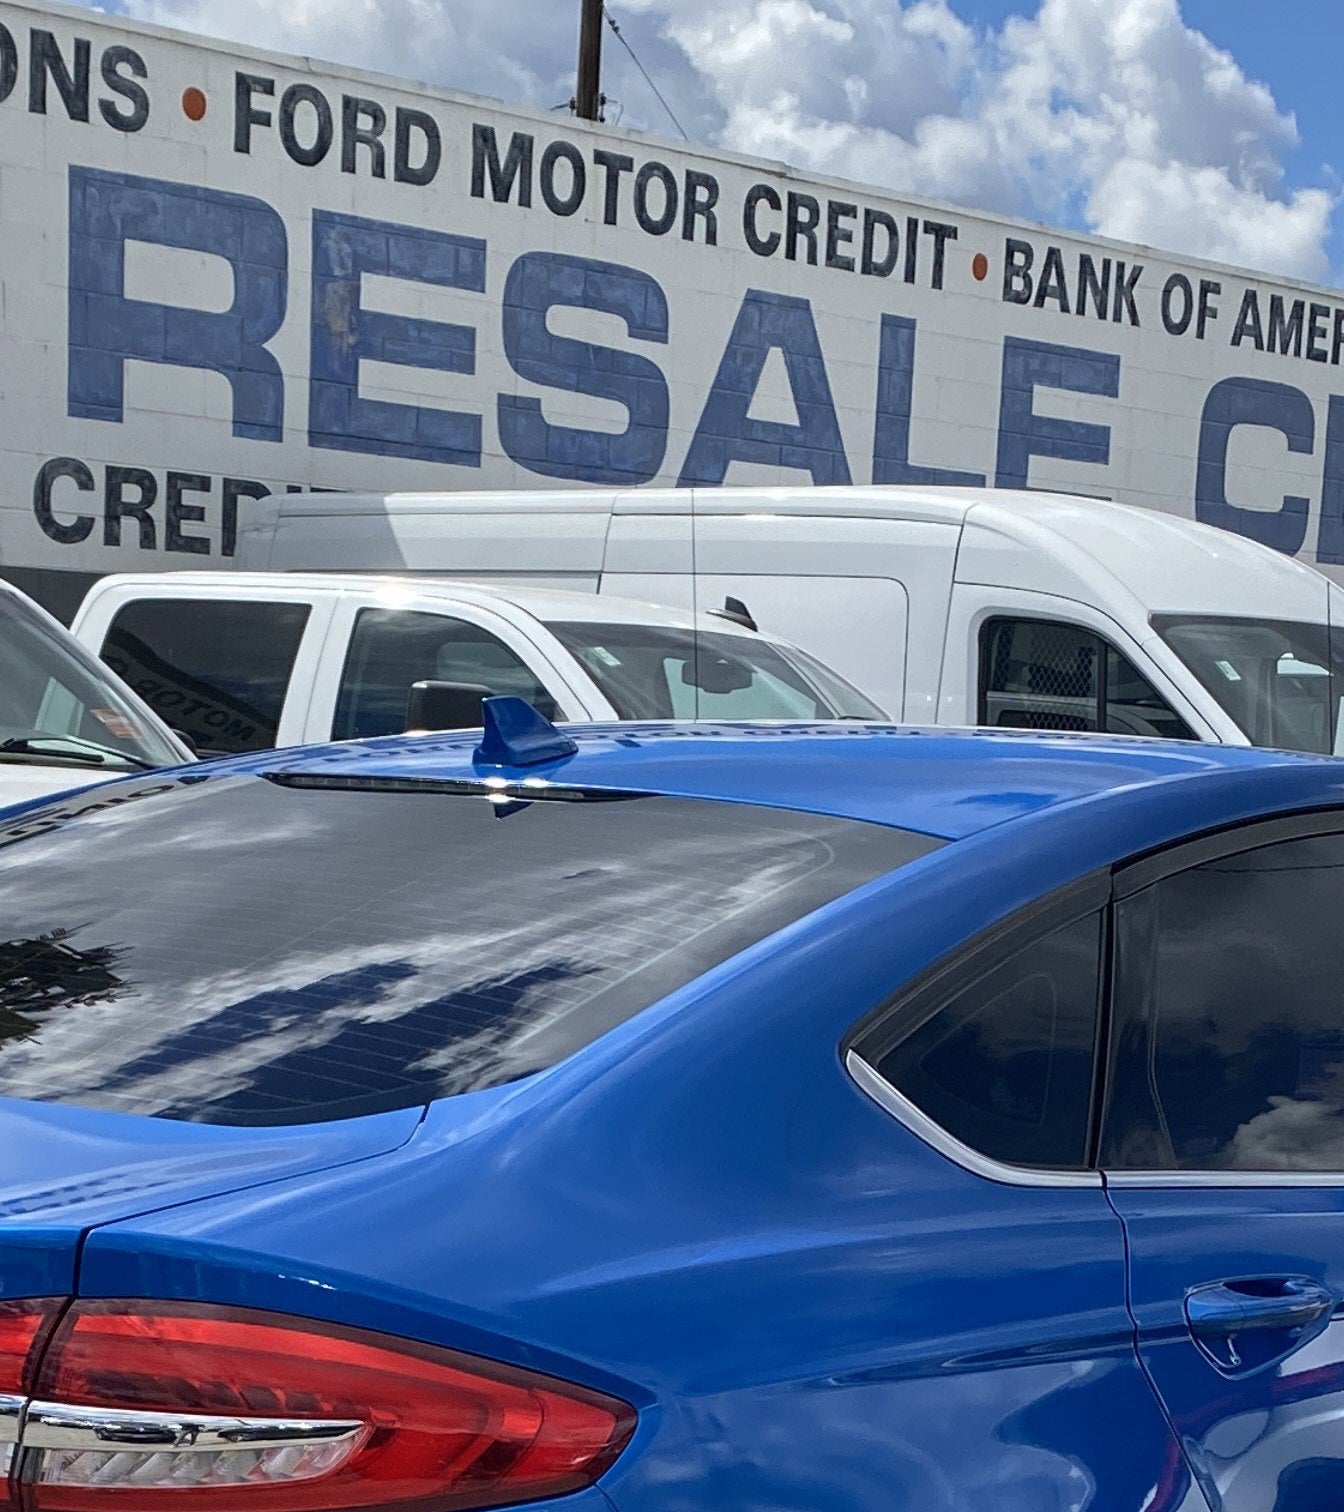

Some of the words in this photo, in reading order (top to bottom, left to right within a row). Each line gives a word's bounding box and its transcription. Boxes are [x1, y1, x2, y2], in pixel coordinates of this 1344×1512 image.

[67, 165, 1121, 498] RESALE
[234, 71, 442, 187] FORD
[471, 122, 720, 247] MOTOR
[743, 183, 959, 291] CREDIT
[1002, 237, 1145, 327] BANK
[1161, 271, 1222, 341] OF
[33, 456, 352, 557] CRED
